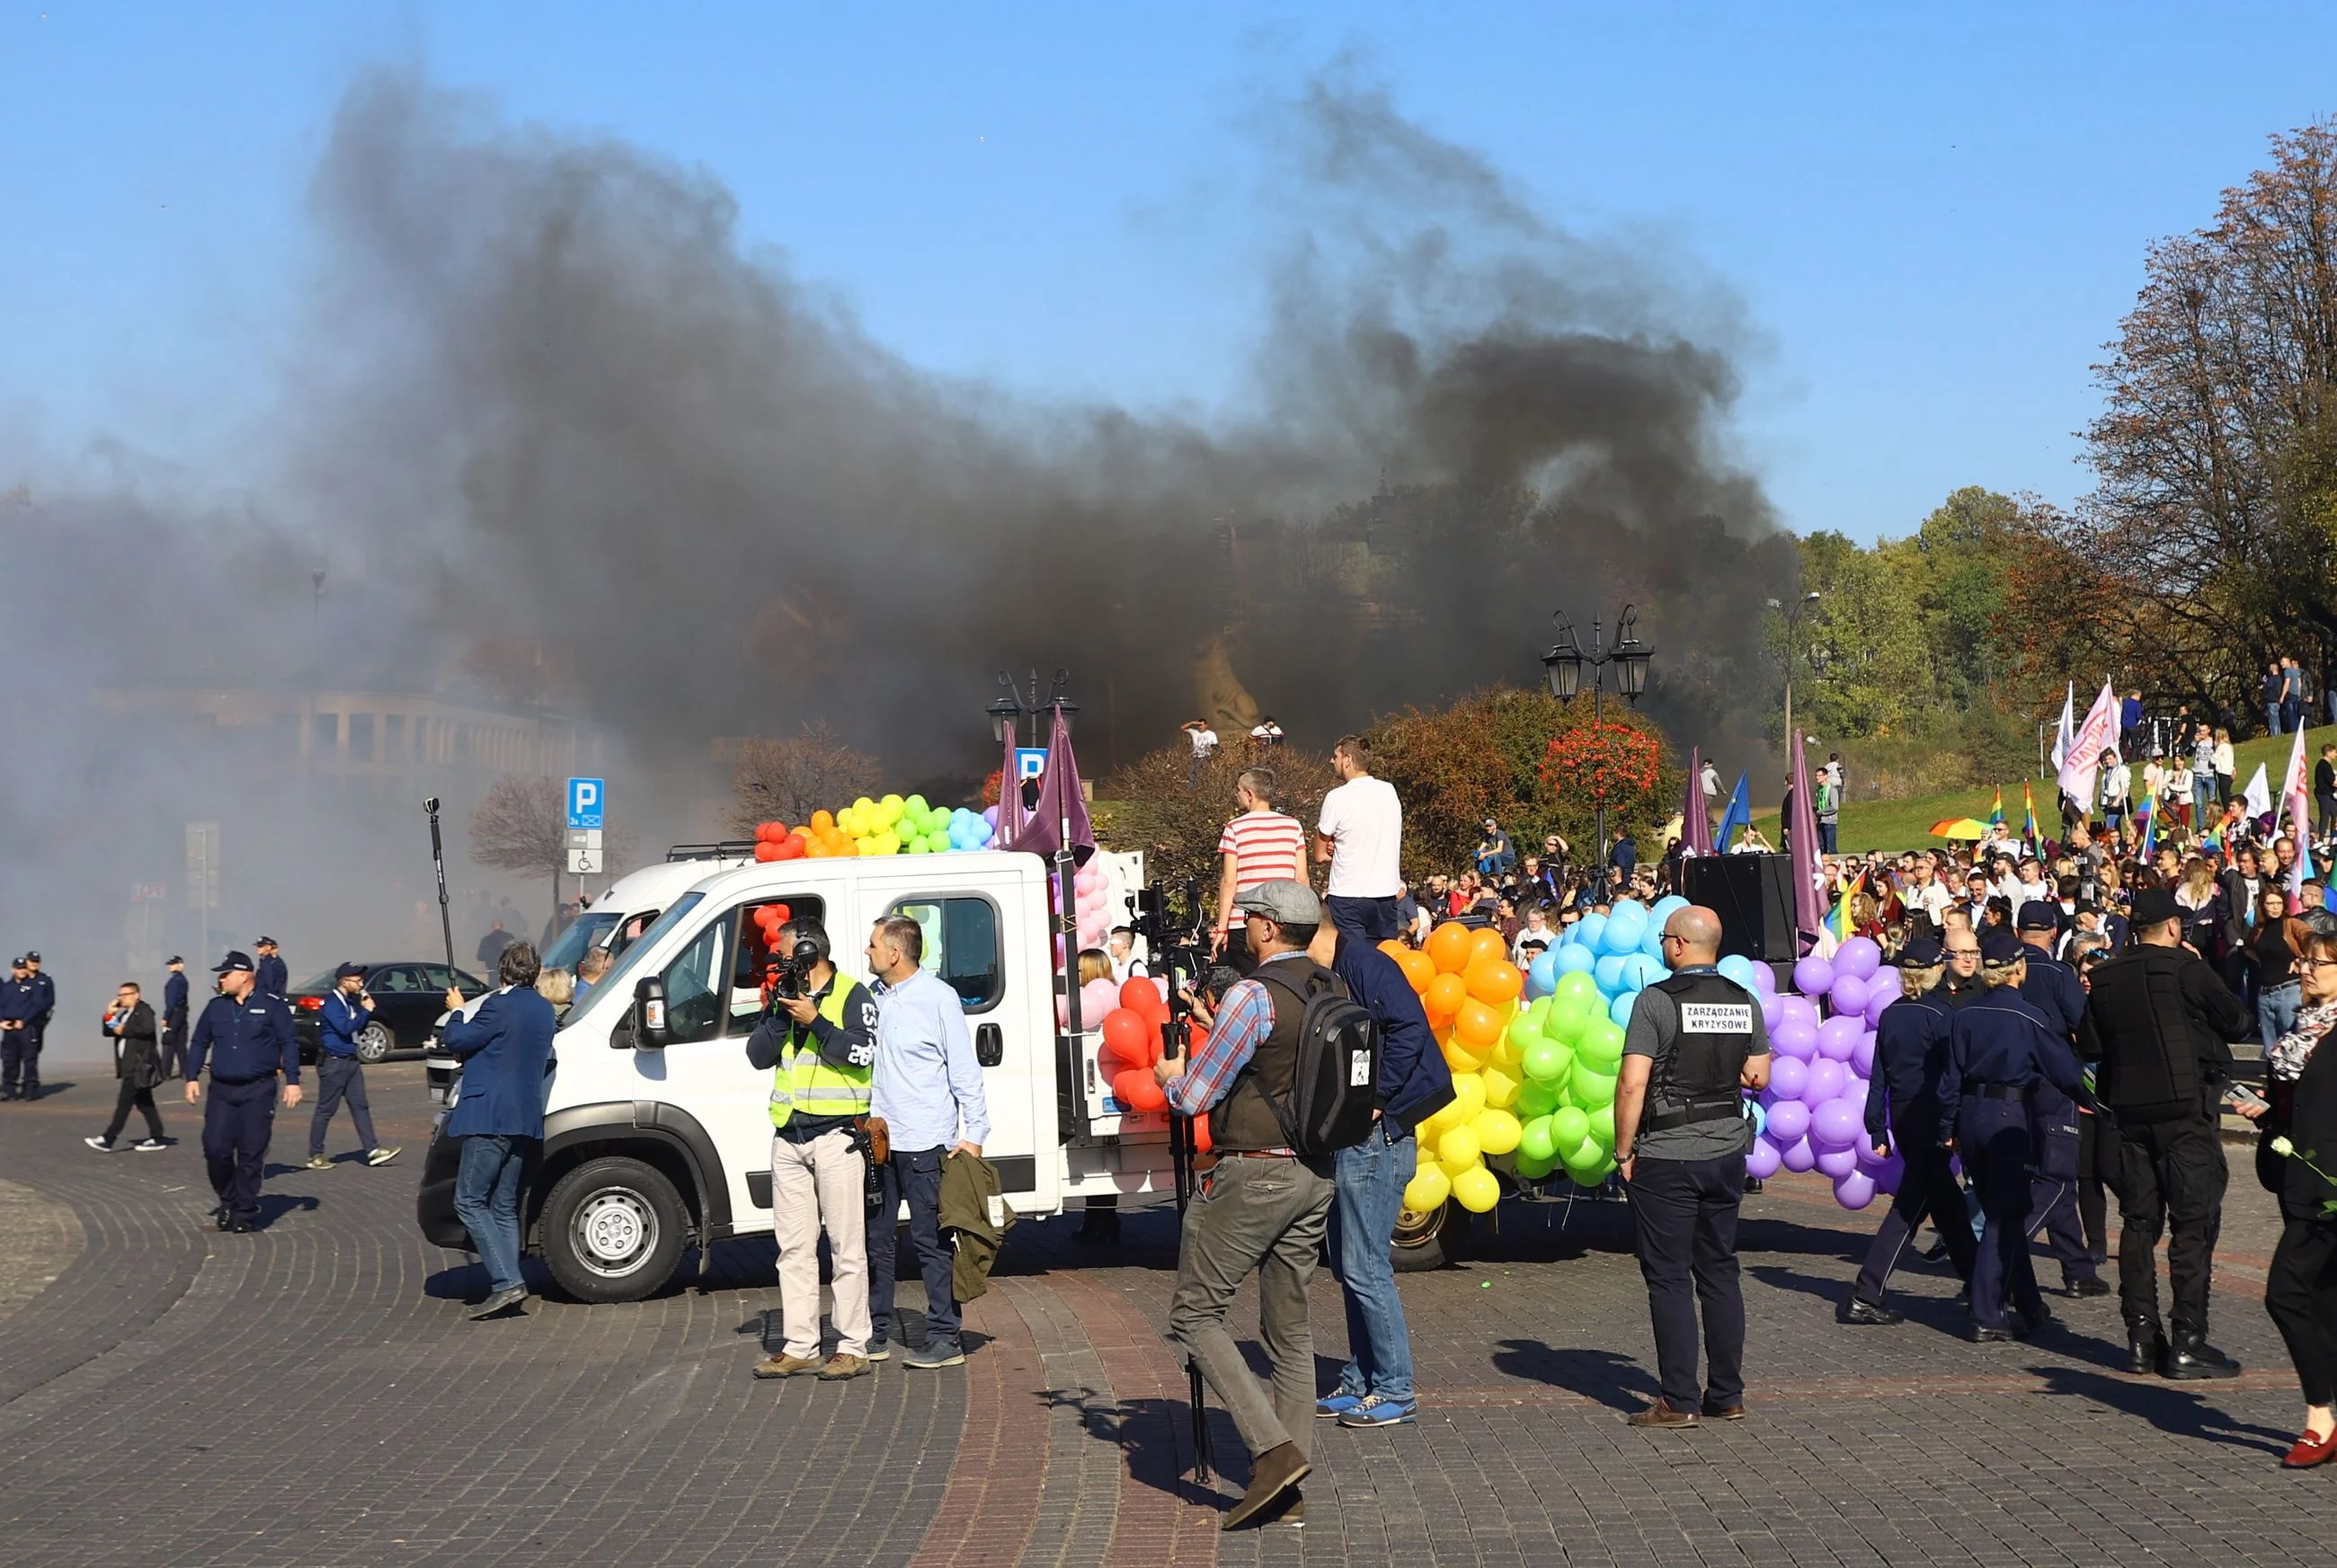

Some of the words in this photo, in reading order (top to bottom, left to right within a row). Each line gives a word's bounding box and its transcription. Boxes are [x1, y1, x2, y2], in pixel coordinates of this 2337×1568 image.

[1021, 754, 1044, 780] P
[576, 783, 597, 814] P
[1687, 1007, 1749, 1018] ZARZĄDZANIE
[1691, 1020, 1747, 1030] KRYZYSOWE
